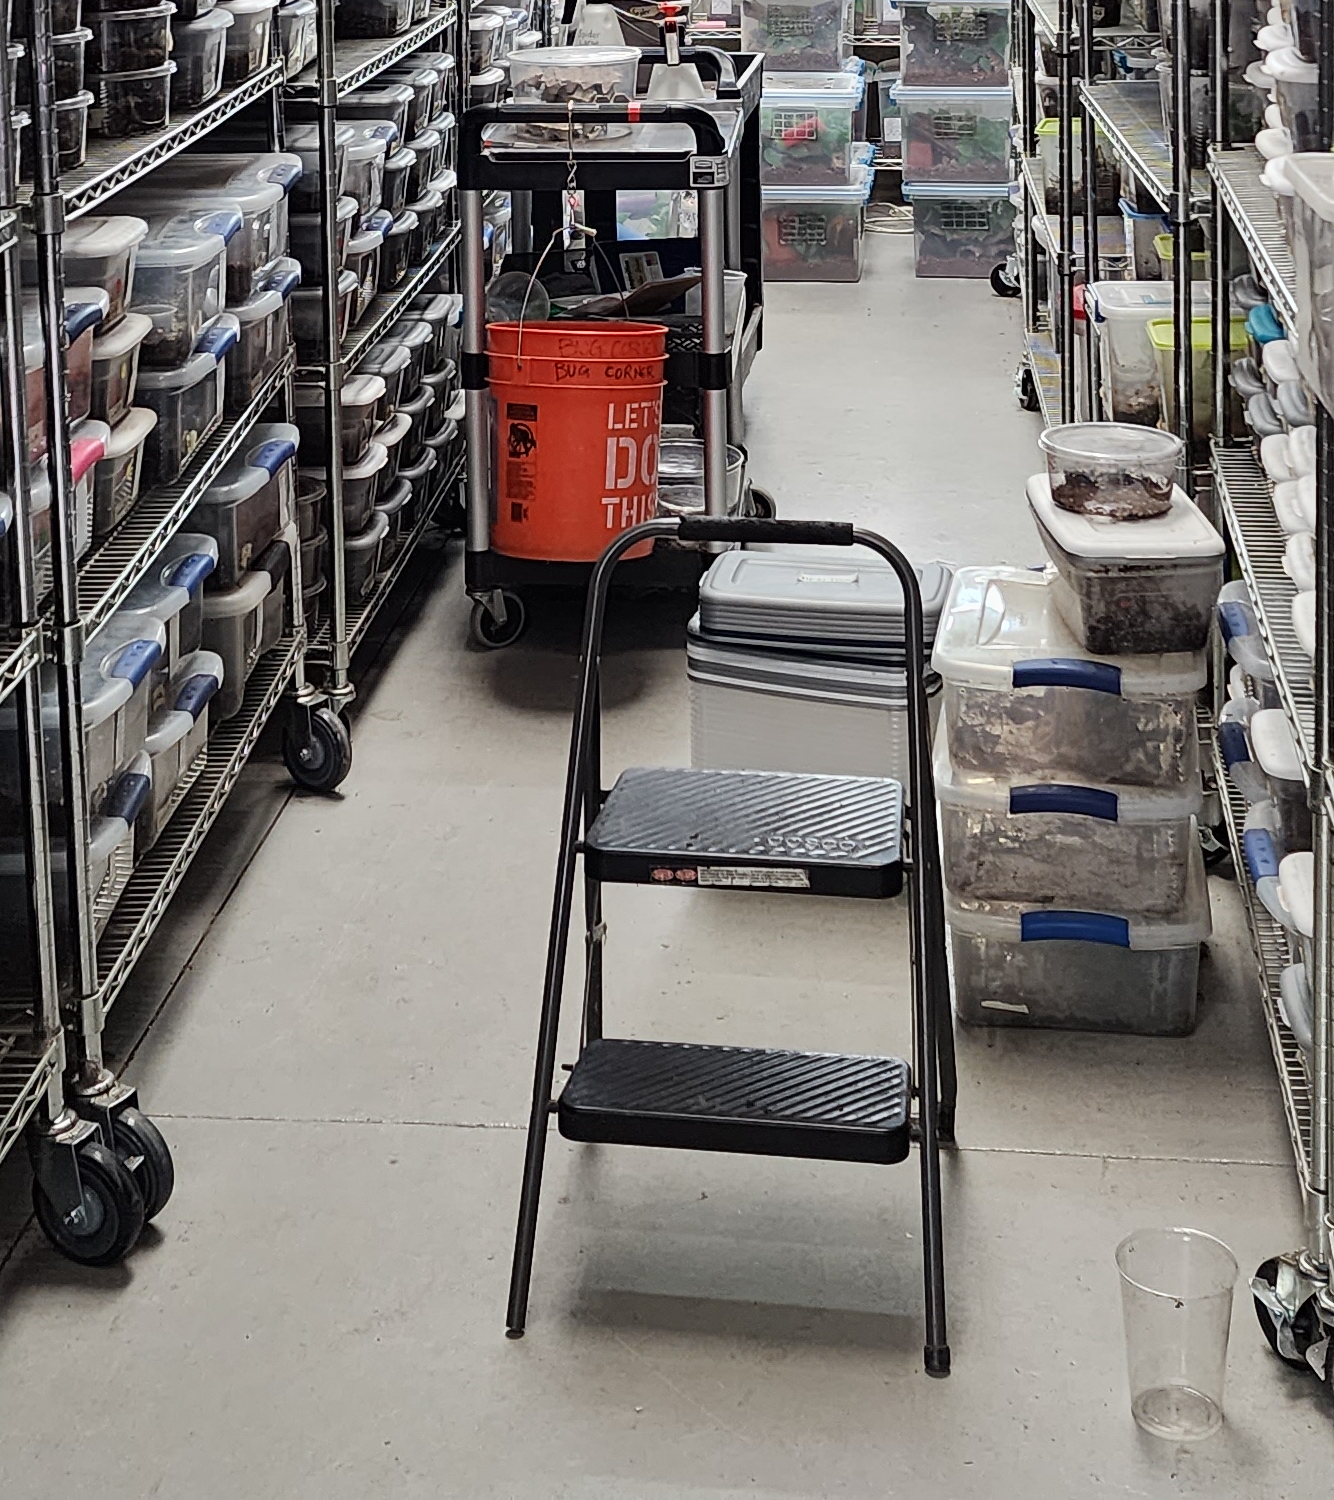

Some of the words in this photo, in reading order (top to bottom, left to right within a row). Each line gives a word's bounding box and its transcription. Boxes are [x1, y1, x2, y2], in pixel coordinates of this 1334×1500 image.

[555, 363, 590, 381] BUG
[605, 364, 655, 380] CORNER
[608, 401, 659, 429] LET'S
[605, 434, 659, 489] DO
[601, 492, 657, 528] THIS
